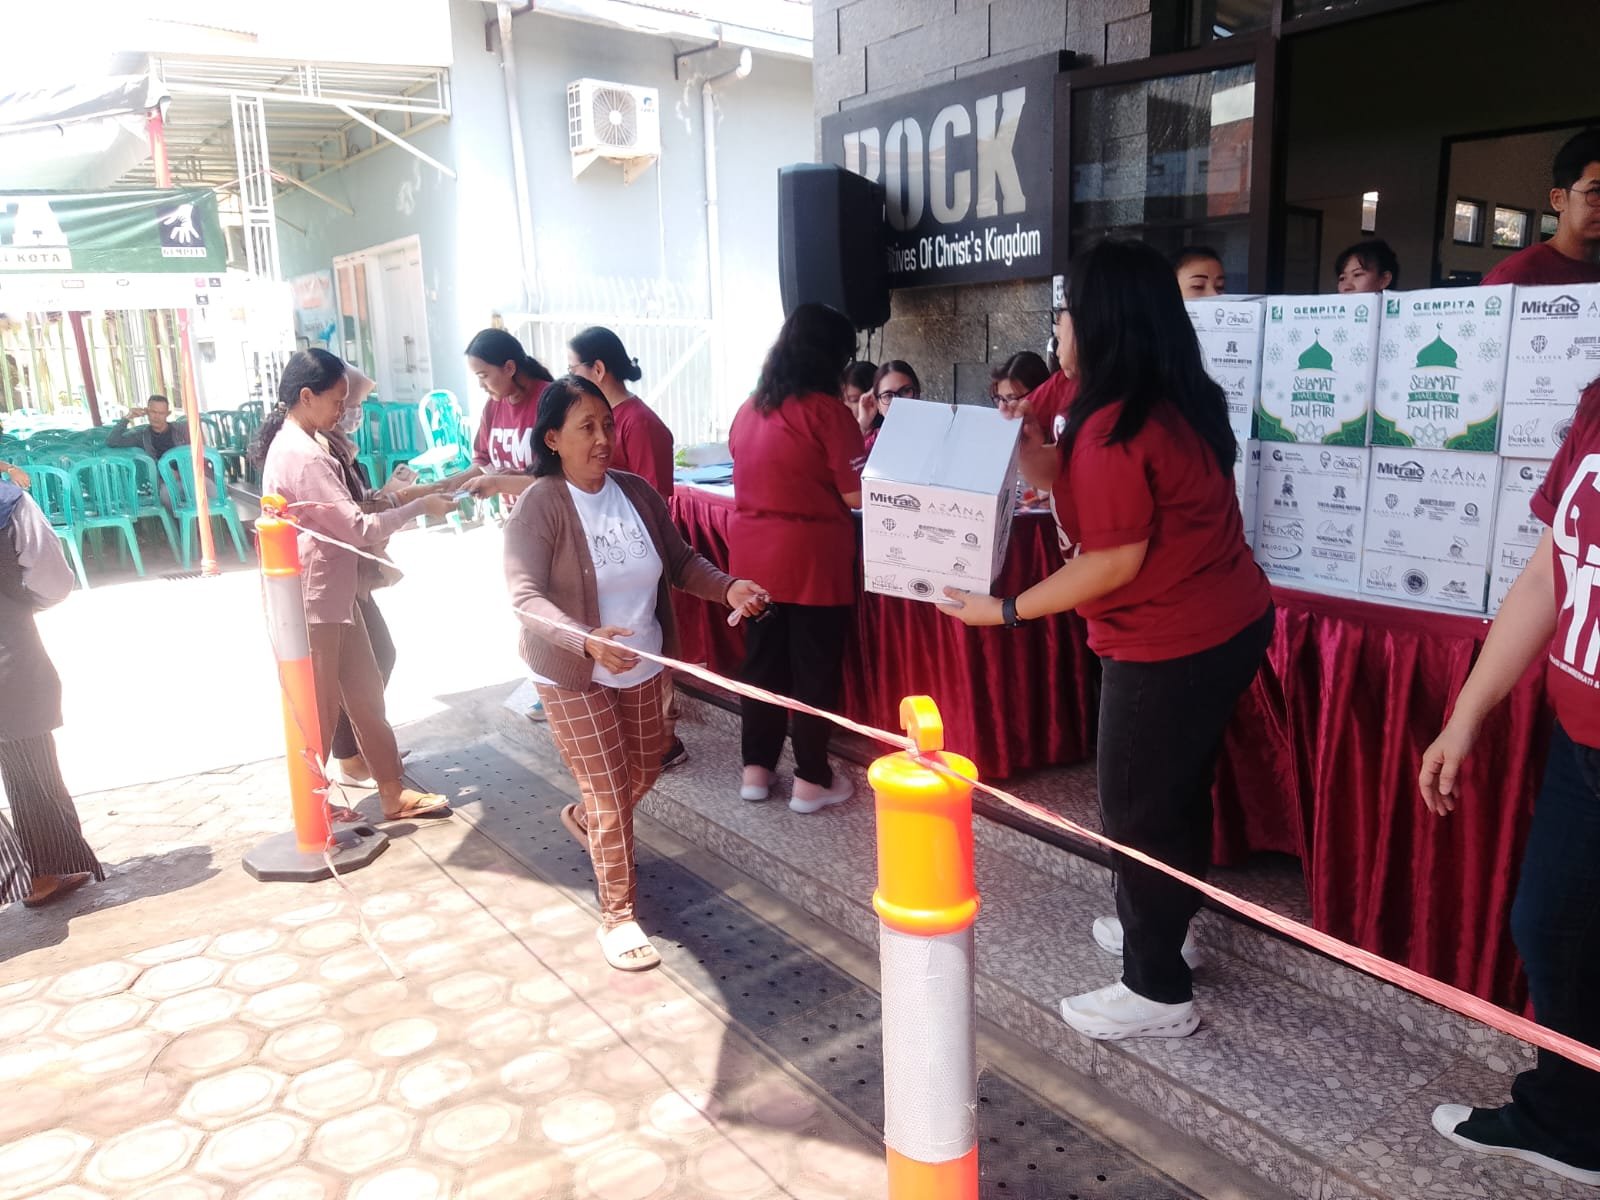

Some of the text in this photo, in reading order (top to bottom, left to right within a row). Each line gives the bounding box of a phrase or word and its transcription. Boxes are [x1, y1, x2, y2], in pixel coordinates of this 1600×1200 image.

[919, 236, 933, 270] Of
[935, 230, 982, 268] Christ's
[985, 222, 1041, 267] Kingdom
[17, 253, 61, 263] KOTA
[1293, 305, 1346, 314] GEMPITA
[1413, 300, 1475, 311] GEMPITA
[1293, 376, 1336, 391] SELAMAT
[1409, 375, 1462, 391] SELAMAT
[1312, 403, 1335, 419] FITRI
[1432, 403, 1460, 421] FITRI
[1430, 465, 1486, 481] AZANA
[928, 502, 985, 519] AZANA
